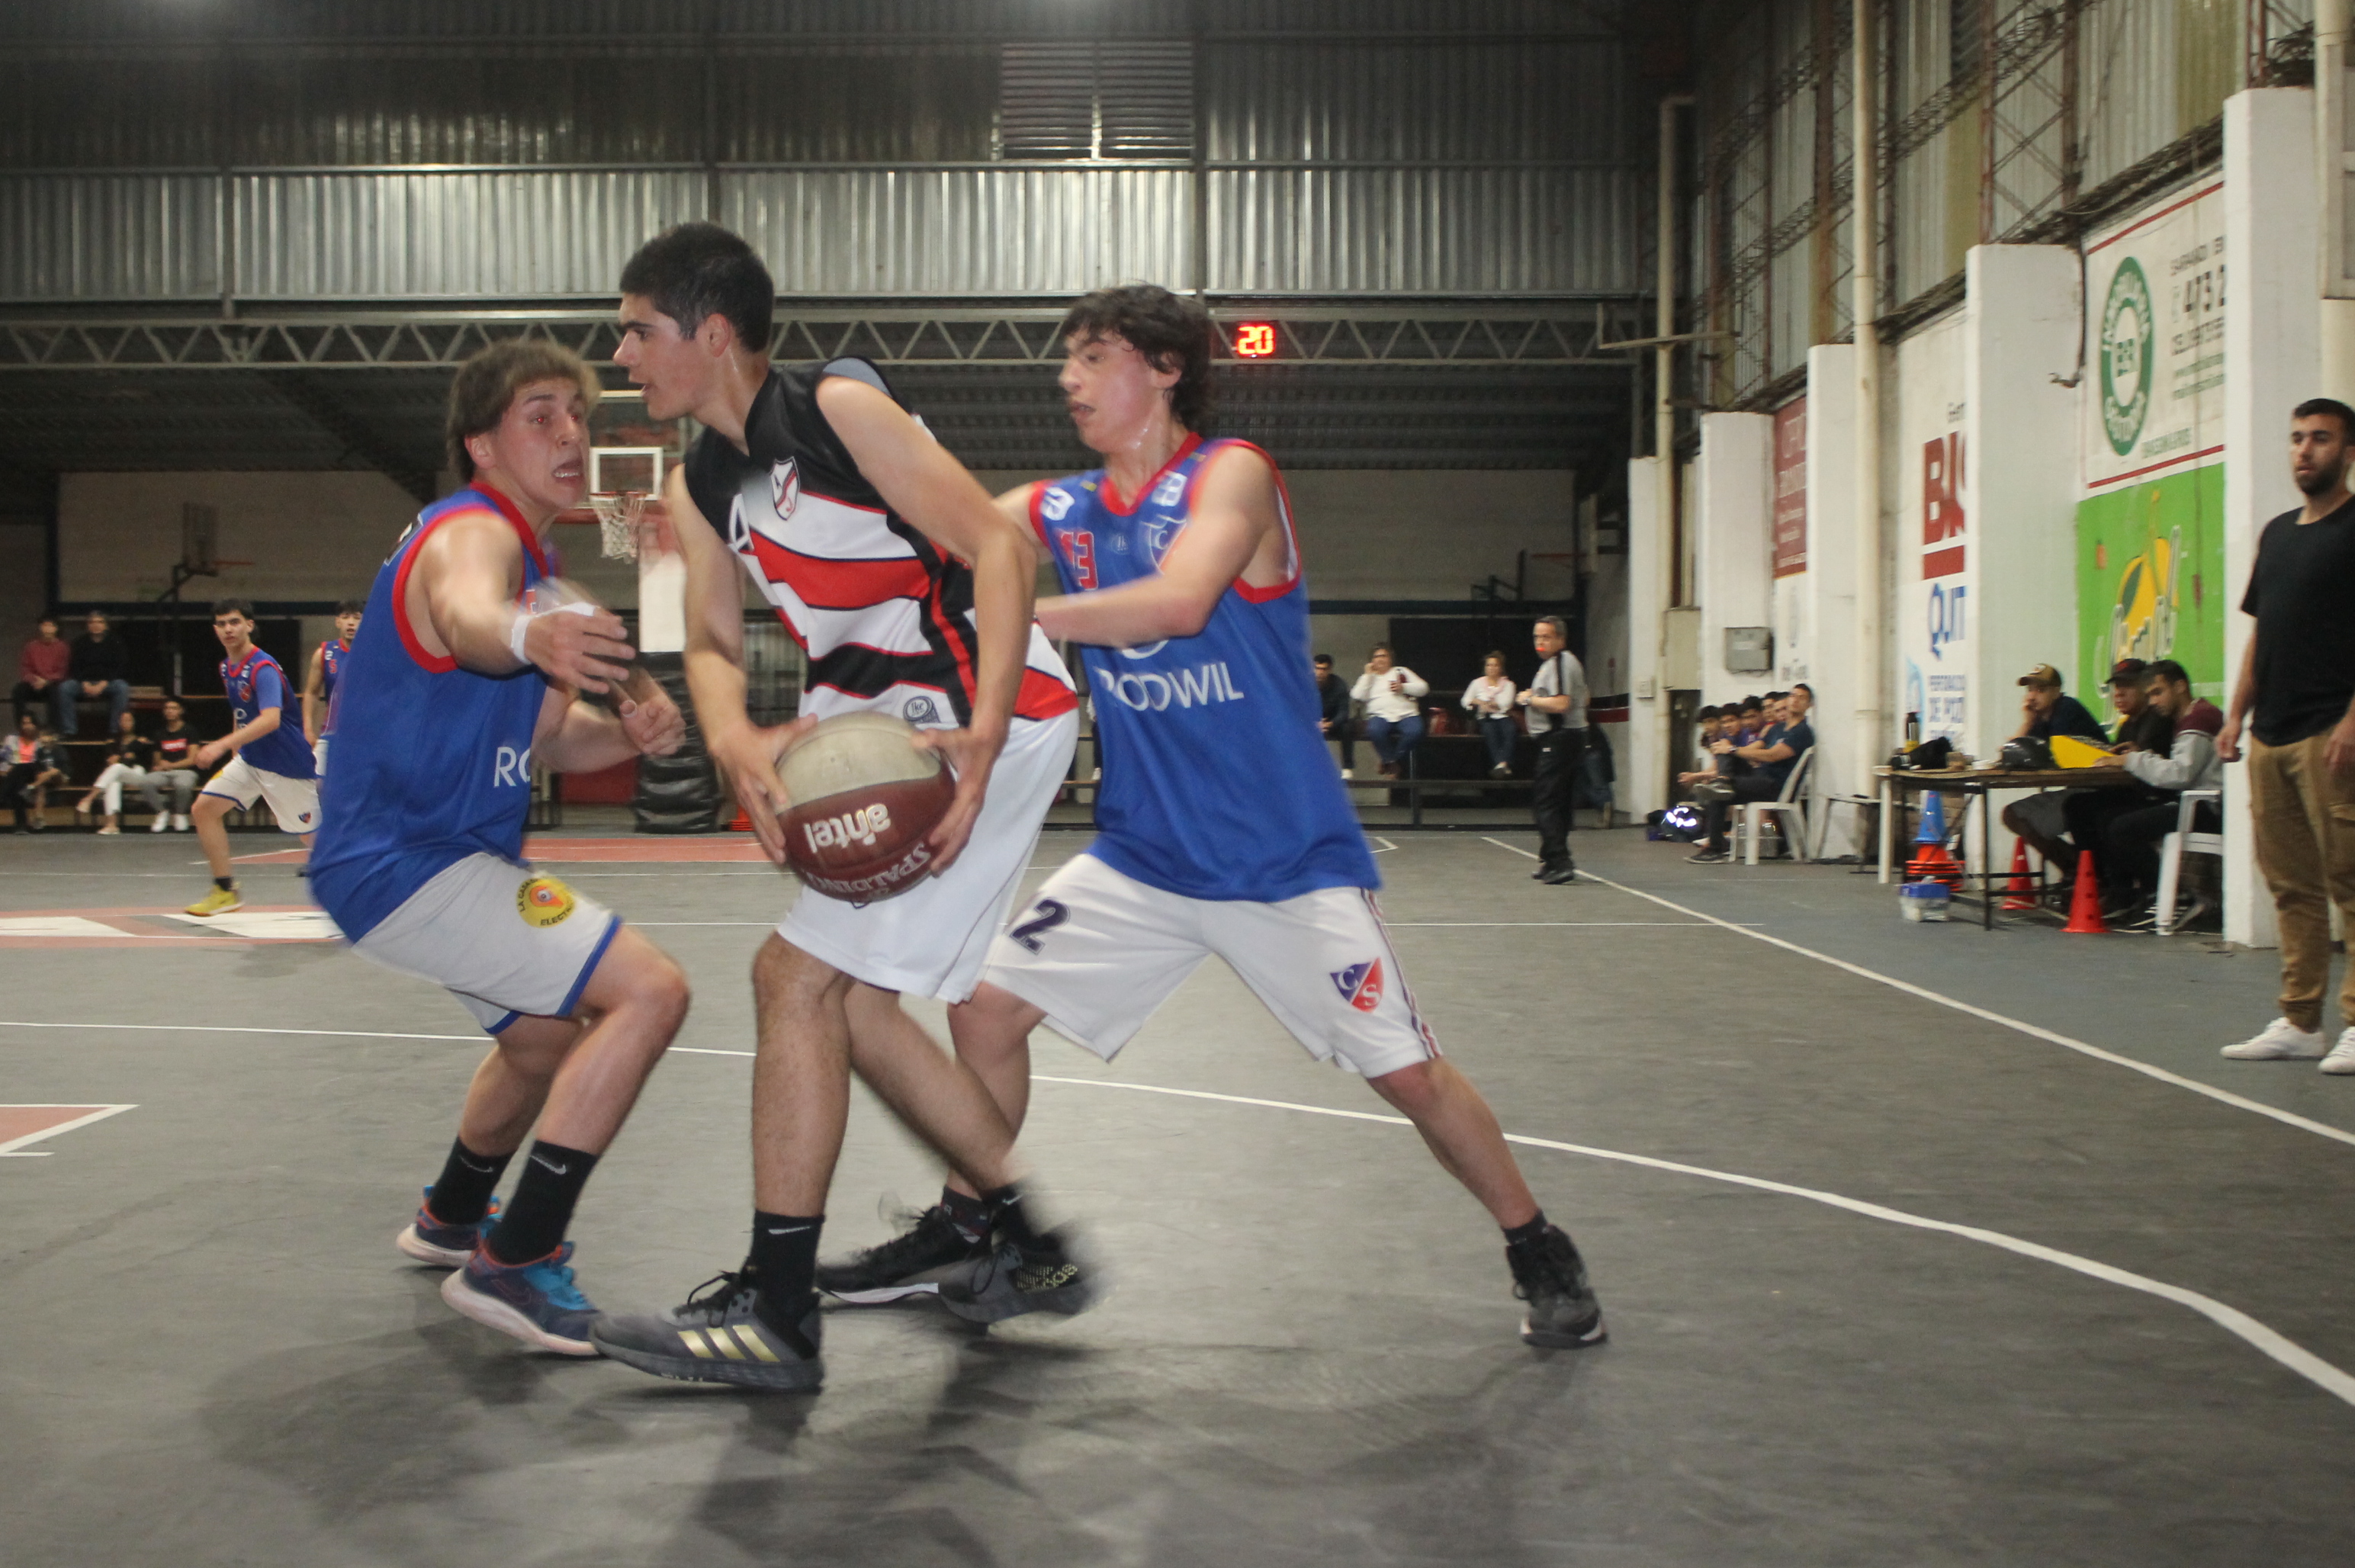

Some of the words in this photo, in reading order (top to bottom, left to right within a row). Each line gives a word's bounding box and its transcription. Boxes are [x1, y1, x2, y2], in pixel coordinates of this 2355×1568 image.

[1237, 326, 1274, 355] 20
[803, 803, 892, 853] antel
[1009, 896, 1071, 956] 2
